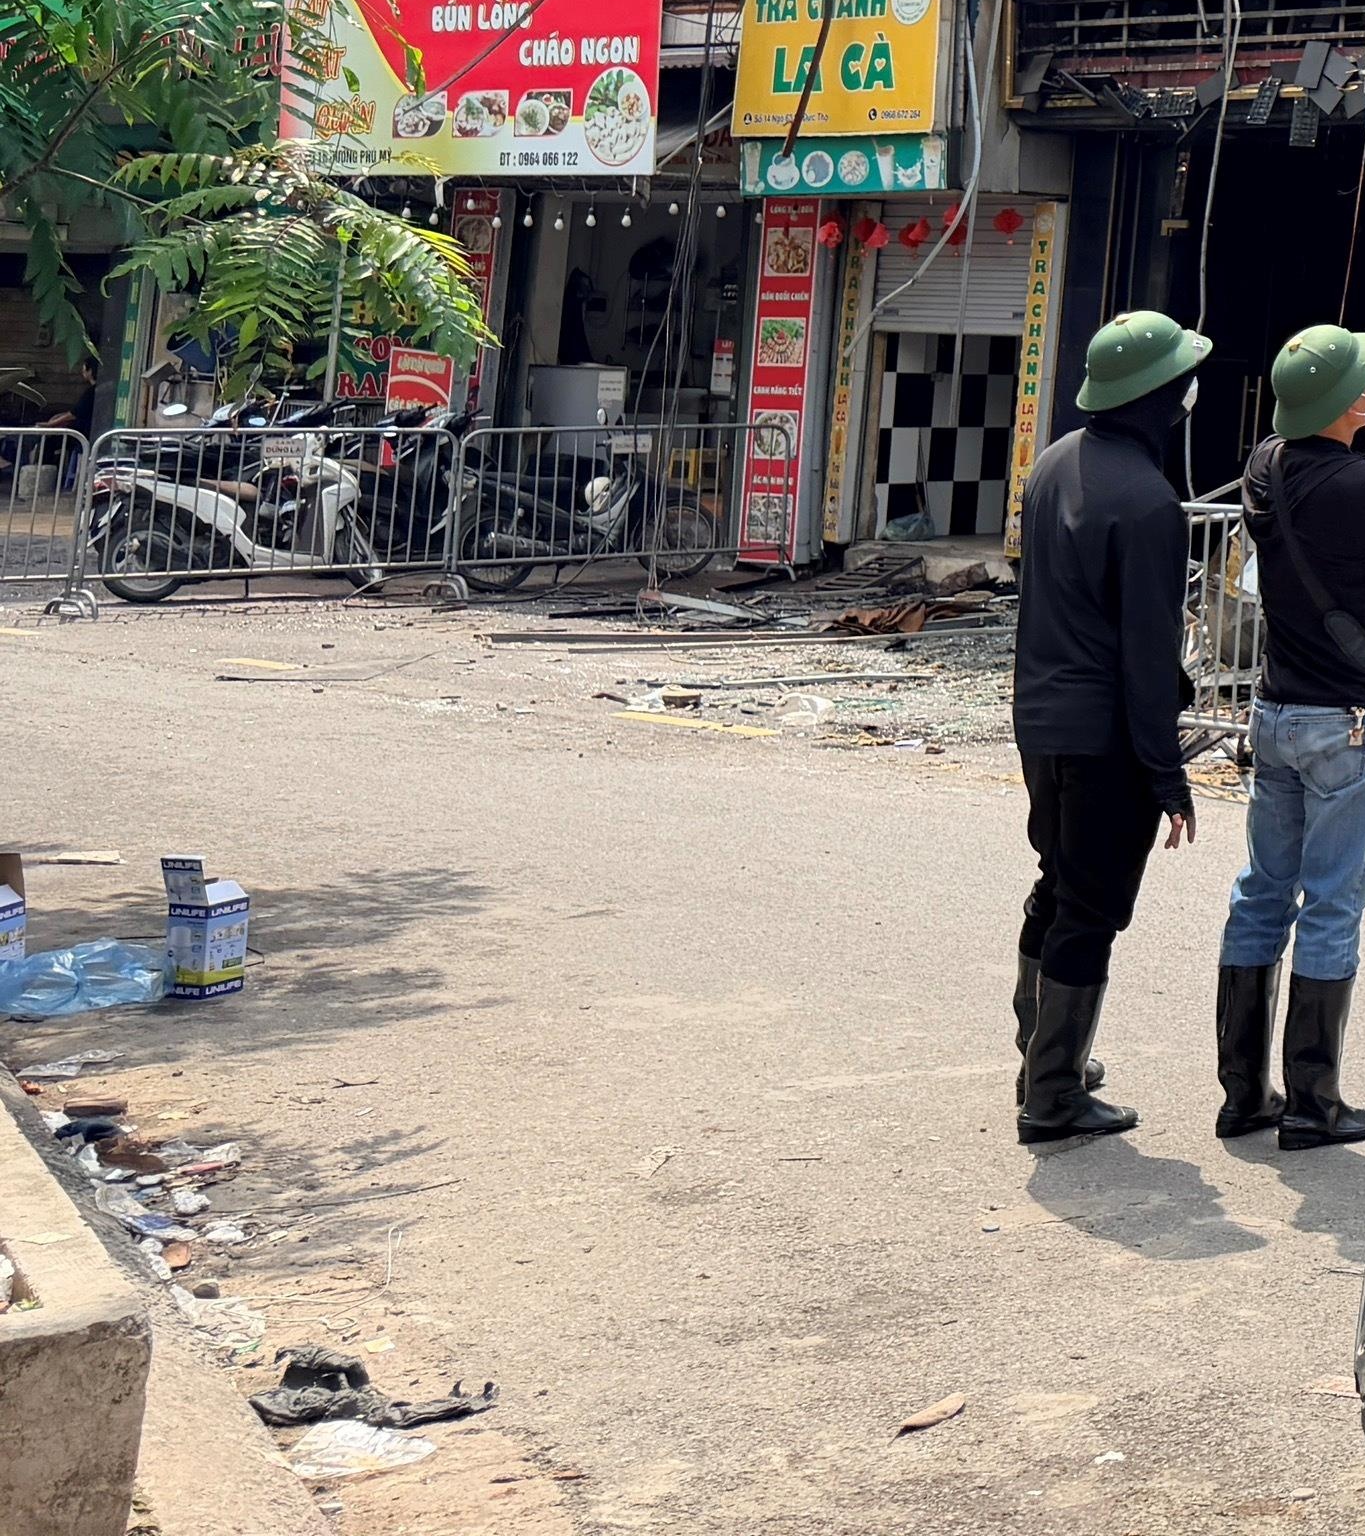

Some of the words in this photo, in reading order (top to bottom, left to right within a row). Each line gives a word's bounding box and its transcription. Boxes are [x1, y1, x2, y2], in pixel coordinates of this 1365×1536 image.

[518, 31, 576, 67] CHÁO
[580, 35, 641, 65] NGON
[771, 44, 824, 95] LA
[840, 31, 896, 93] CÀ
[518, 152, 540, 166] 0964
[562, 152, 579, 165] 122
[170, 907, 207, 918] UNILIFE
[211, 901, 248, 917] UNILIFE
[172, 986, 201, 996] NILIFE
[205, 979, 242, 995] UNILIFE
